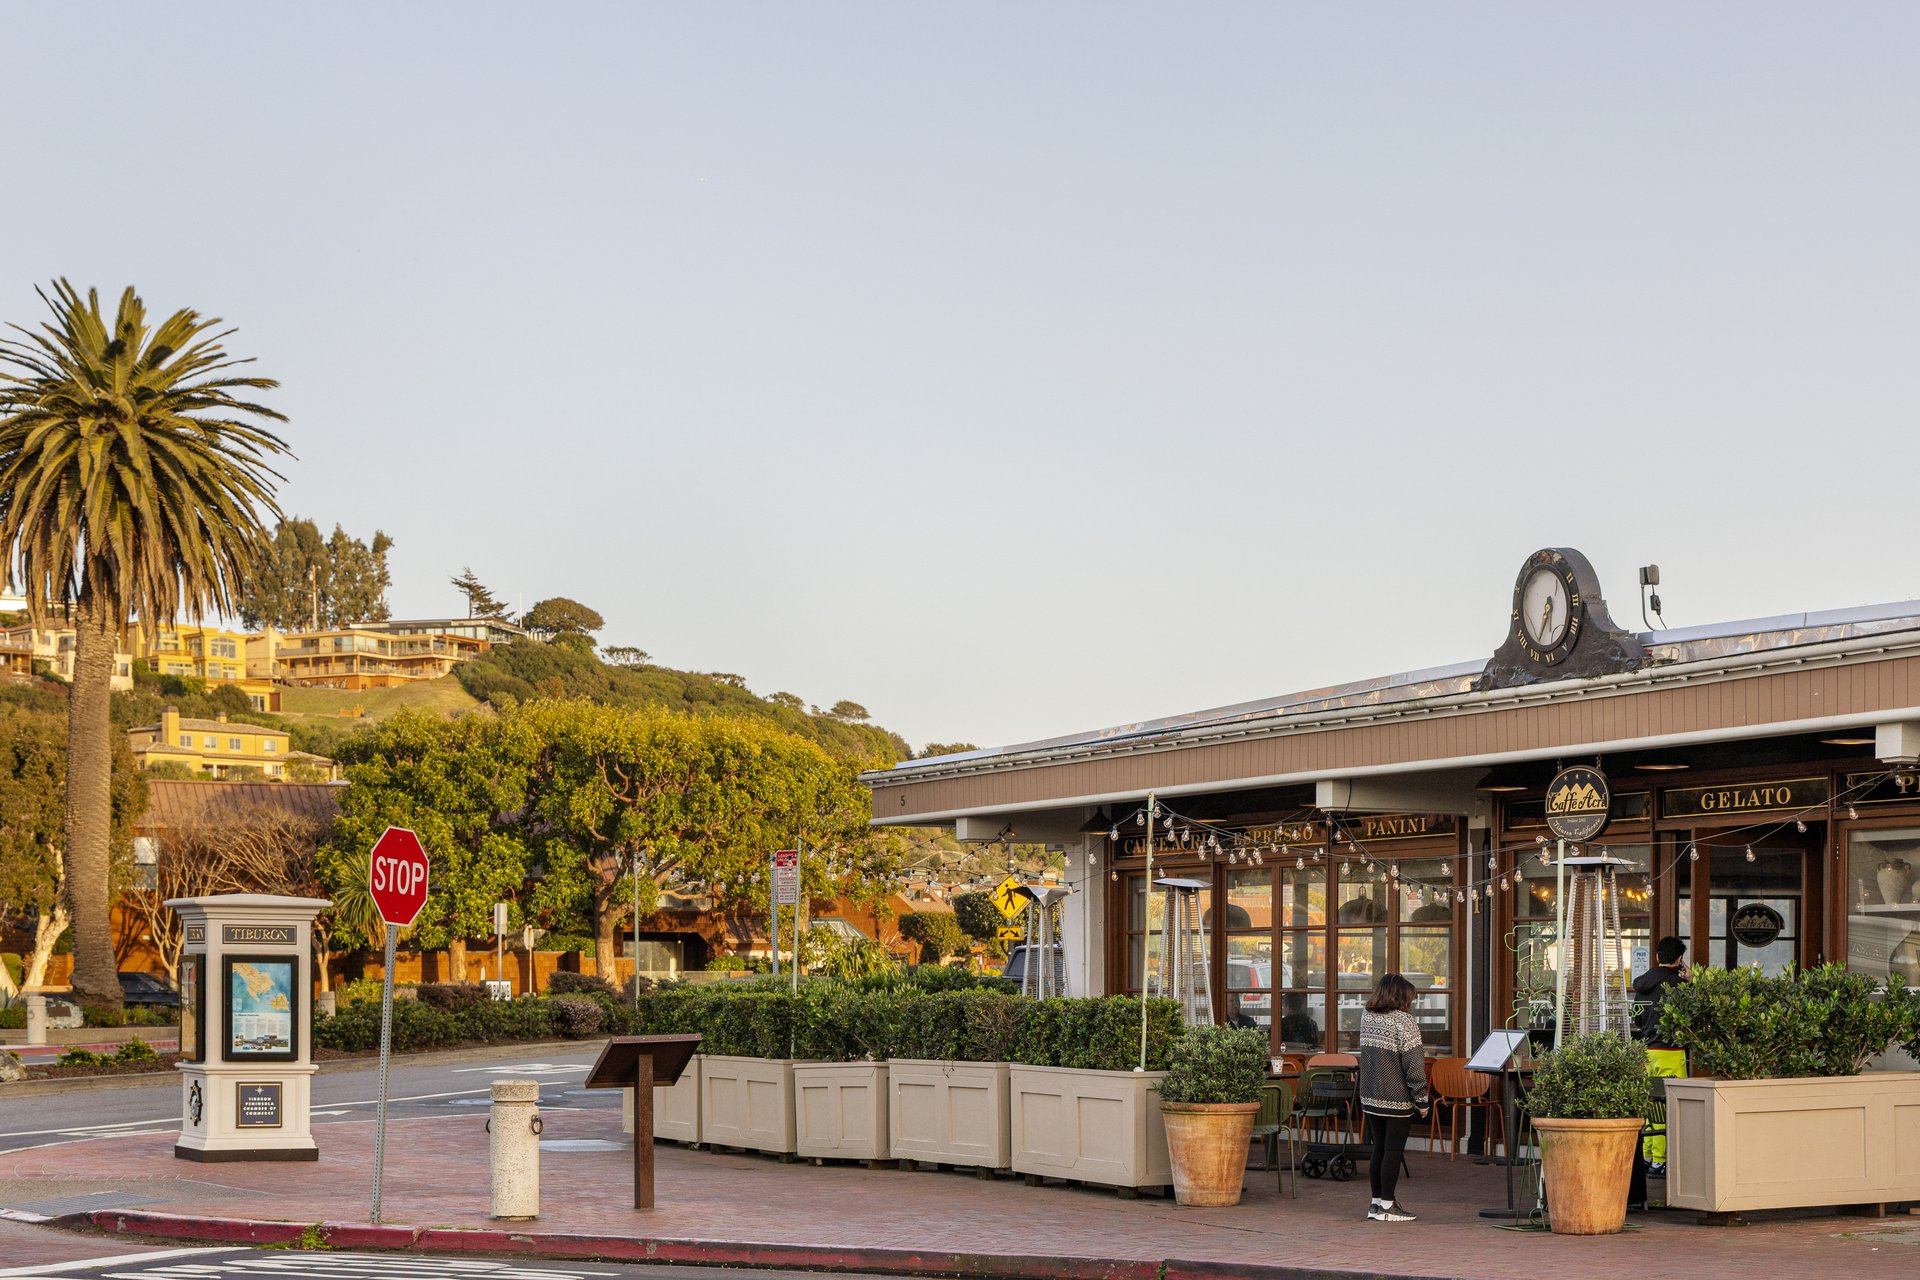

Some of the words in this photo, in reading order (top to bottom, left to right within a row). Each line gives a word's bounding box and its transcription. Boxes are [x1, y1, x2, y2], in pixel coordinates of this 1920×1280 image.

[900, 795, 906, 807] 5
[1701, 787, 1791, 810] GELATO
[1367, 817, 1426, 836] PANINI
[374, 856, 425, 896] STOP
[231, 928, 288, 940] TIBURON
